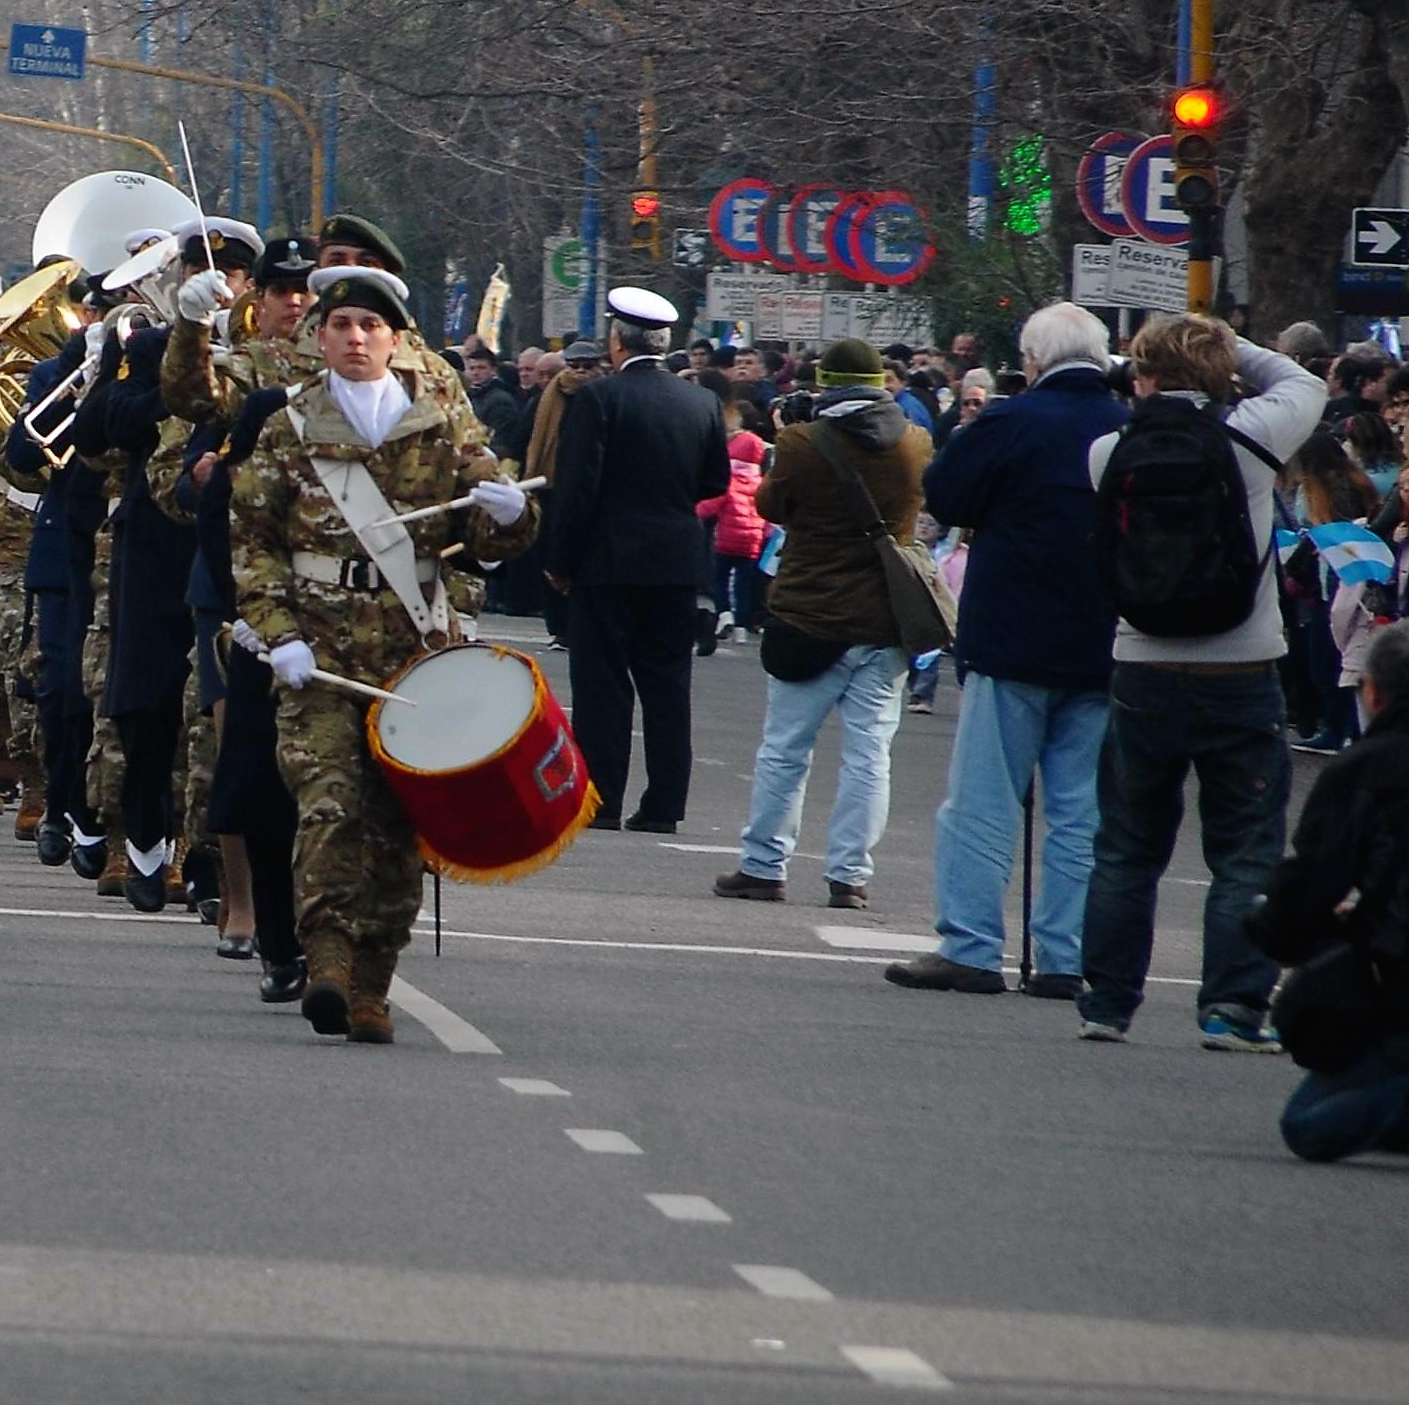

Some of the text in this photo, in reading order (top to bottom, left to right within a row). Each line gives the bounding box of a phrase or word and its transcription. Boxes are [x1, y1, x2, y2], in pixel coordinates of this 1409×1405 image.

[23, 42, 70, 59] NUEVA
[11, 57, 79, 76] TERMINAL
[114, 175, 145, 186] CONN
[1145, 157, 1191, 224] E
